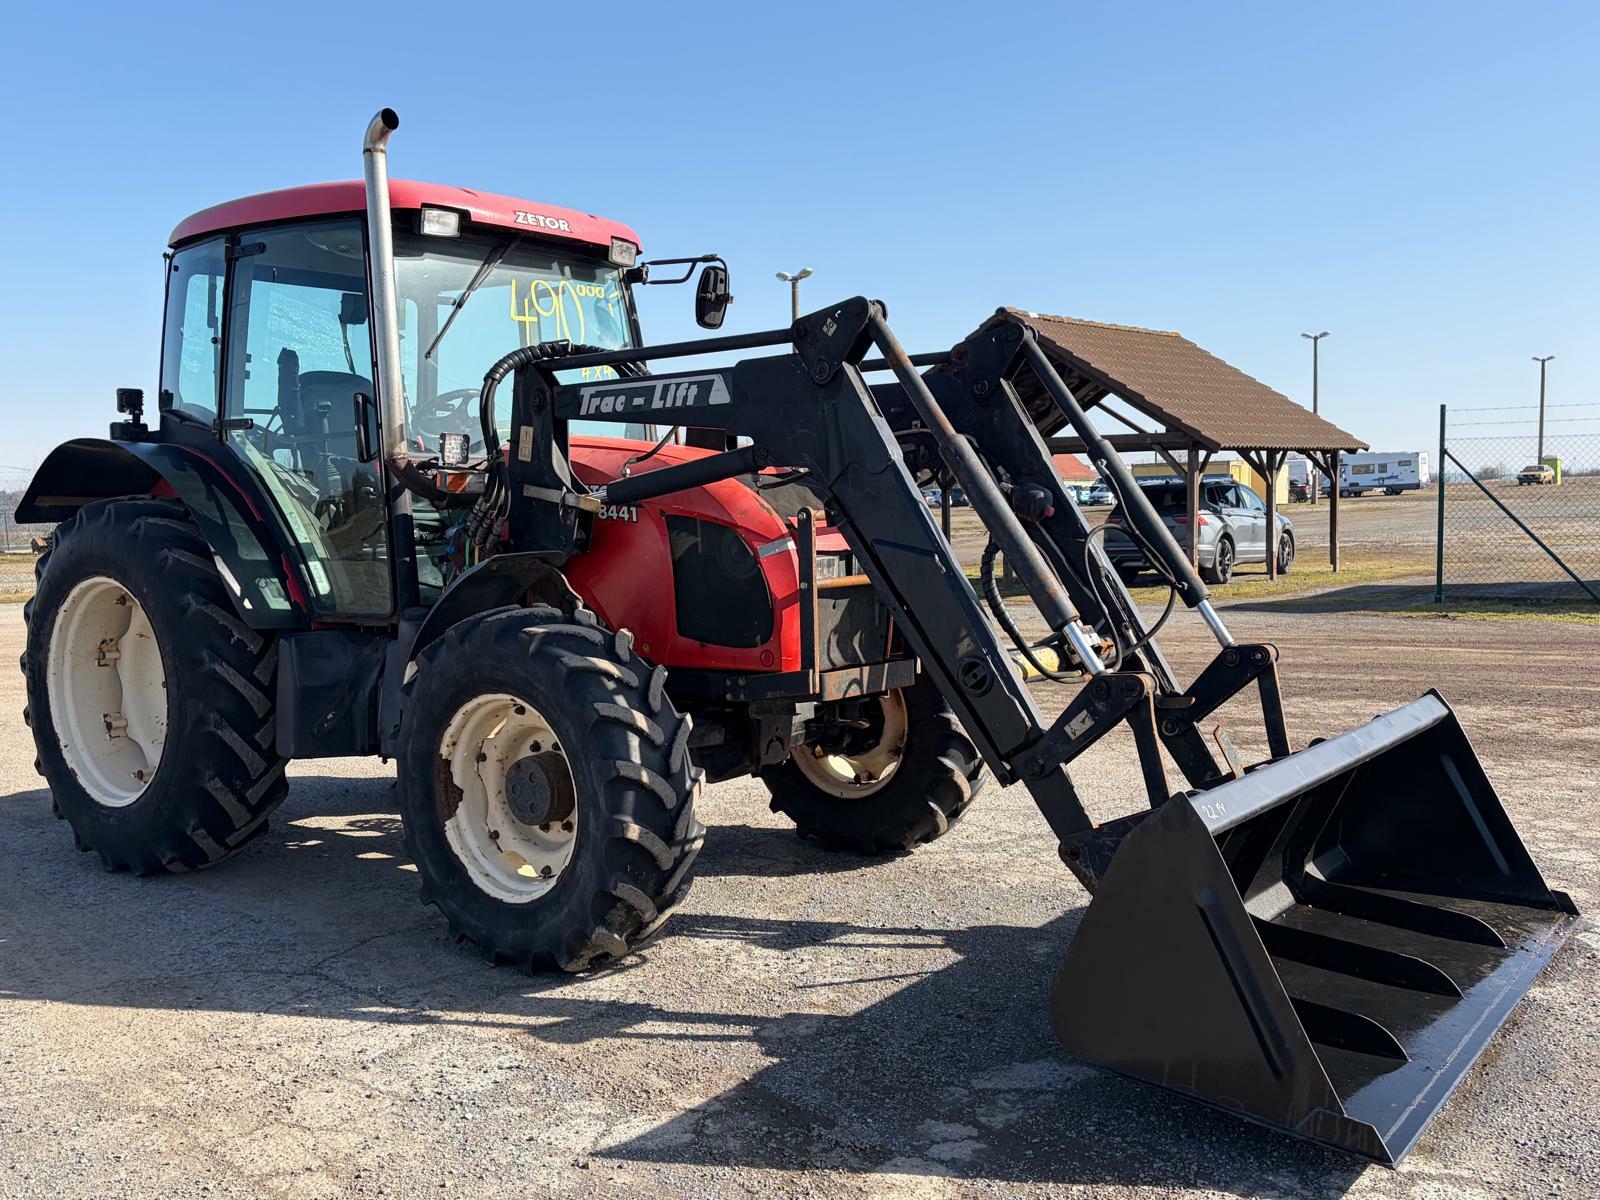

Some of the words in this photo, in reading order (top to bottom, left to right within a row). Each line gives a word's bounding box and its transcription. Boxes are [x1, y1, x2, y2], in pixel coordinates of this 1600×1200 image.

[514, 211, 572, 233] ZETOR
[579, 384, 626, 416] Trac
[651, 380, 699, 409] Lift
[598, 504, 637, 522] 8441
